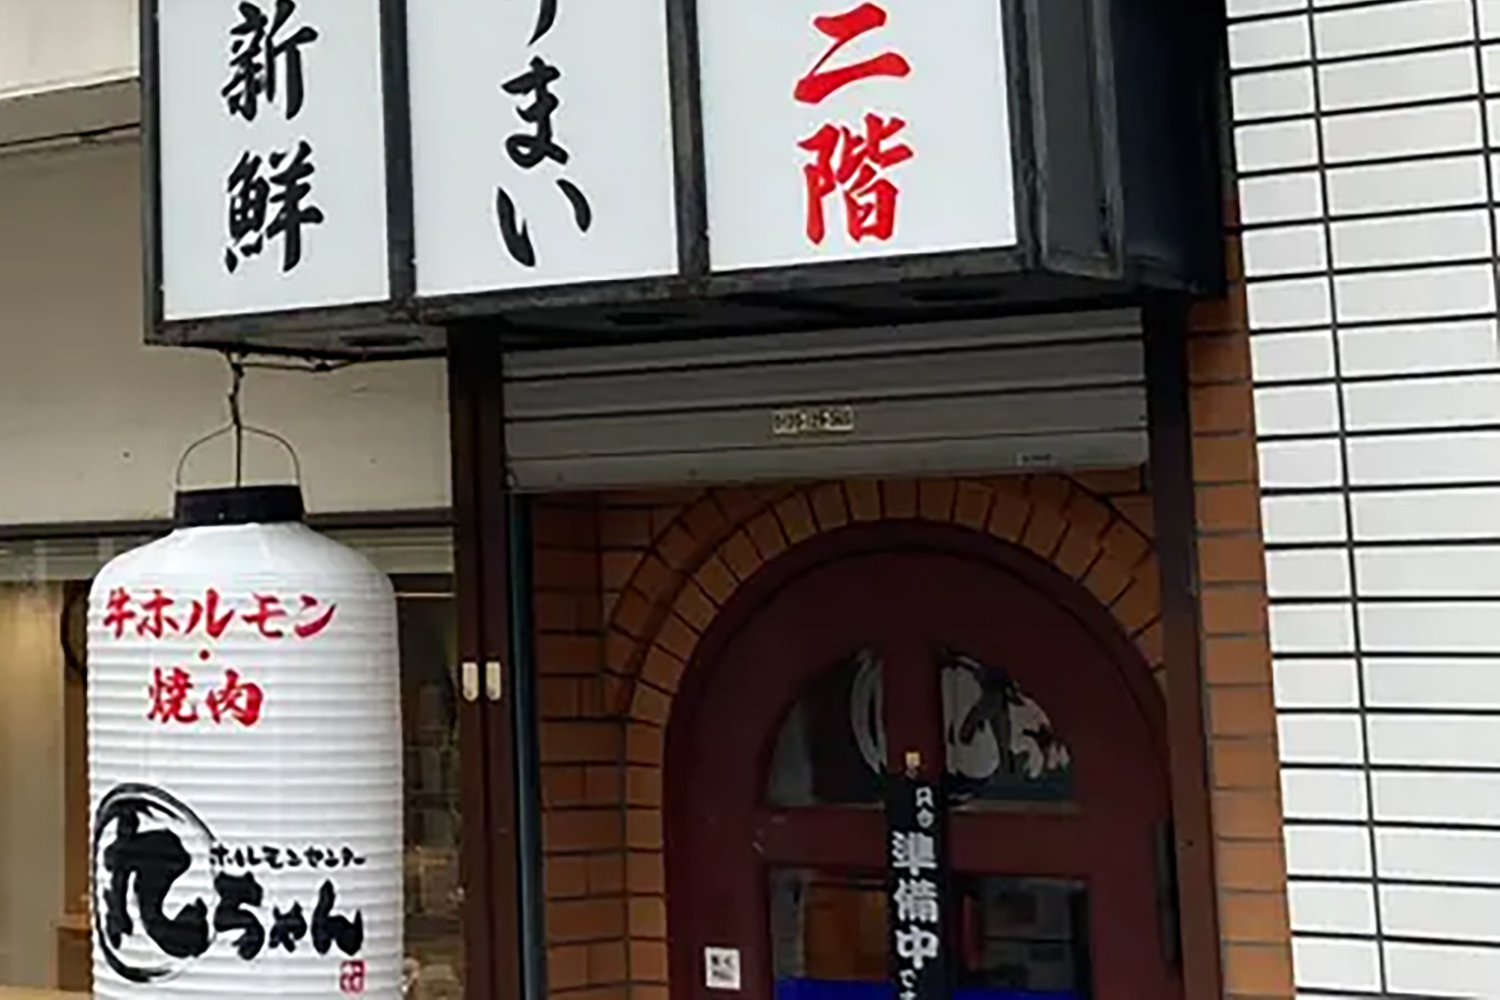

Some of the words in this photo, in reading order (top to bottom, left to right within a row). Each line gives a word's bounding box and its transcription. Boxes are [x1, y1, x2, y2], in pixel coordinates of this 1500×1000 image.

[793, 2, 914, 246] 二階
[103, 589, 337, 641] 牛ホルモン
[146, 667, 265, 728] 焼肉
[101, 802, 365, 960] 丸ちゃん
